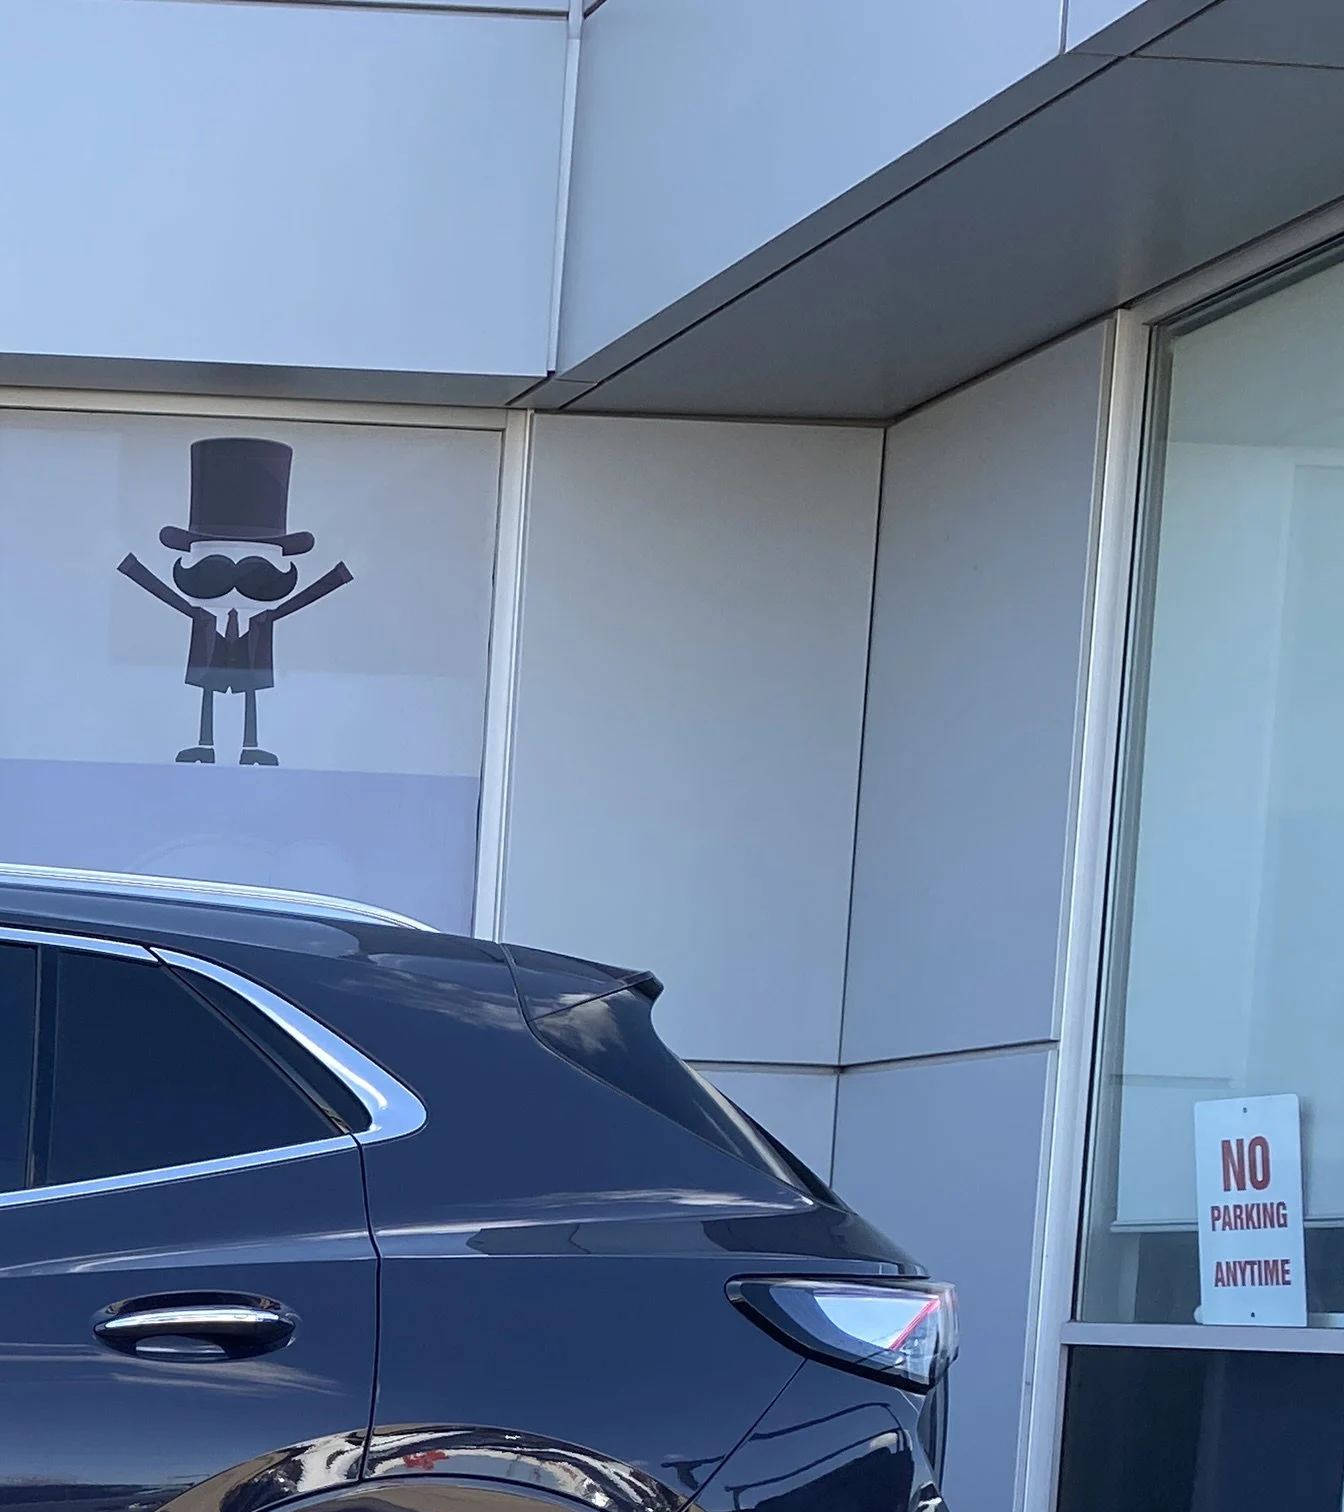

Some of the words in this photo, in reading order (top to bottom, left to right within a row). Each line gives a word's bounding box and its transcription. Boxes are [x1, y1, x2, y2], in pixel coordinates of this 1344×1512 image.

[1221, 1135, 1271, 1192] NO
[1211, 1201, 1288, 1232] PARKING
[1214, 1258, 1292, 1288] ANYTIME
